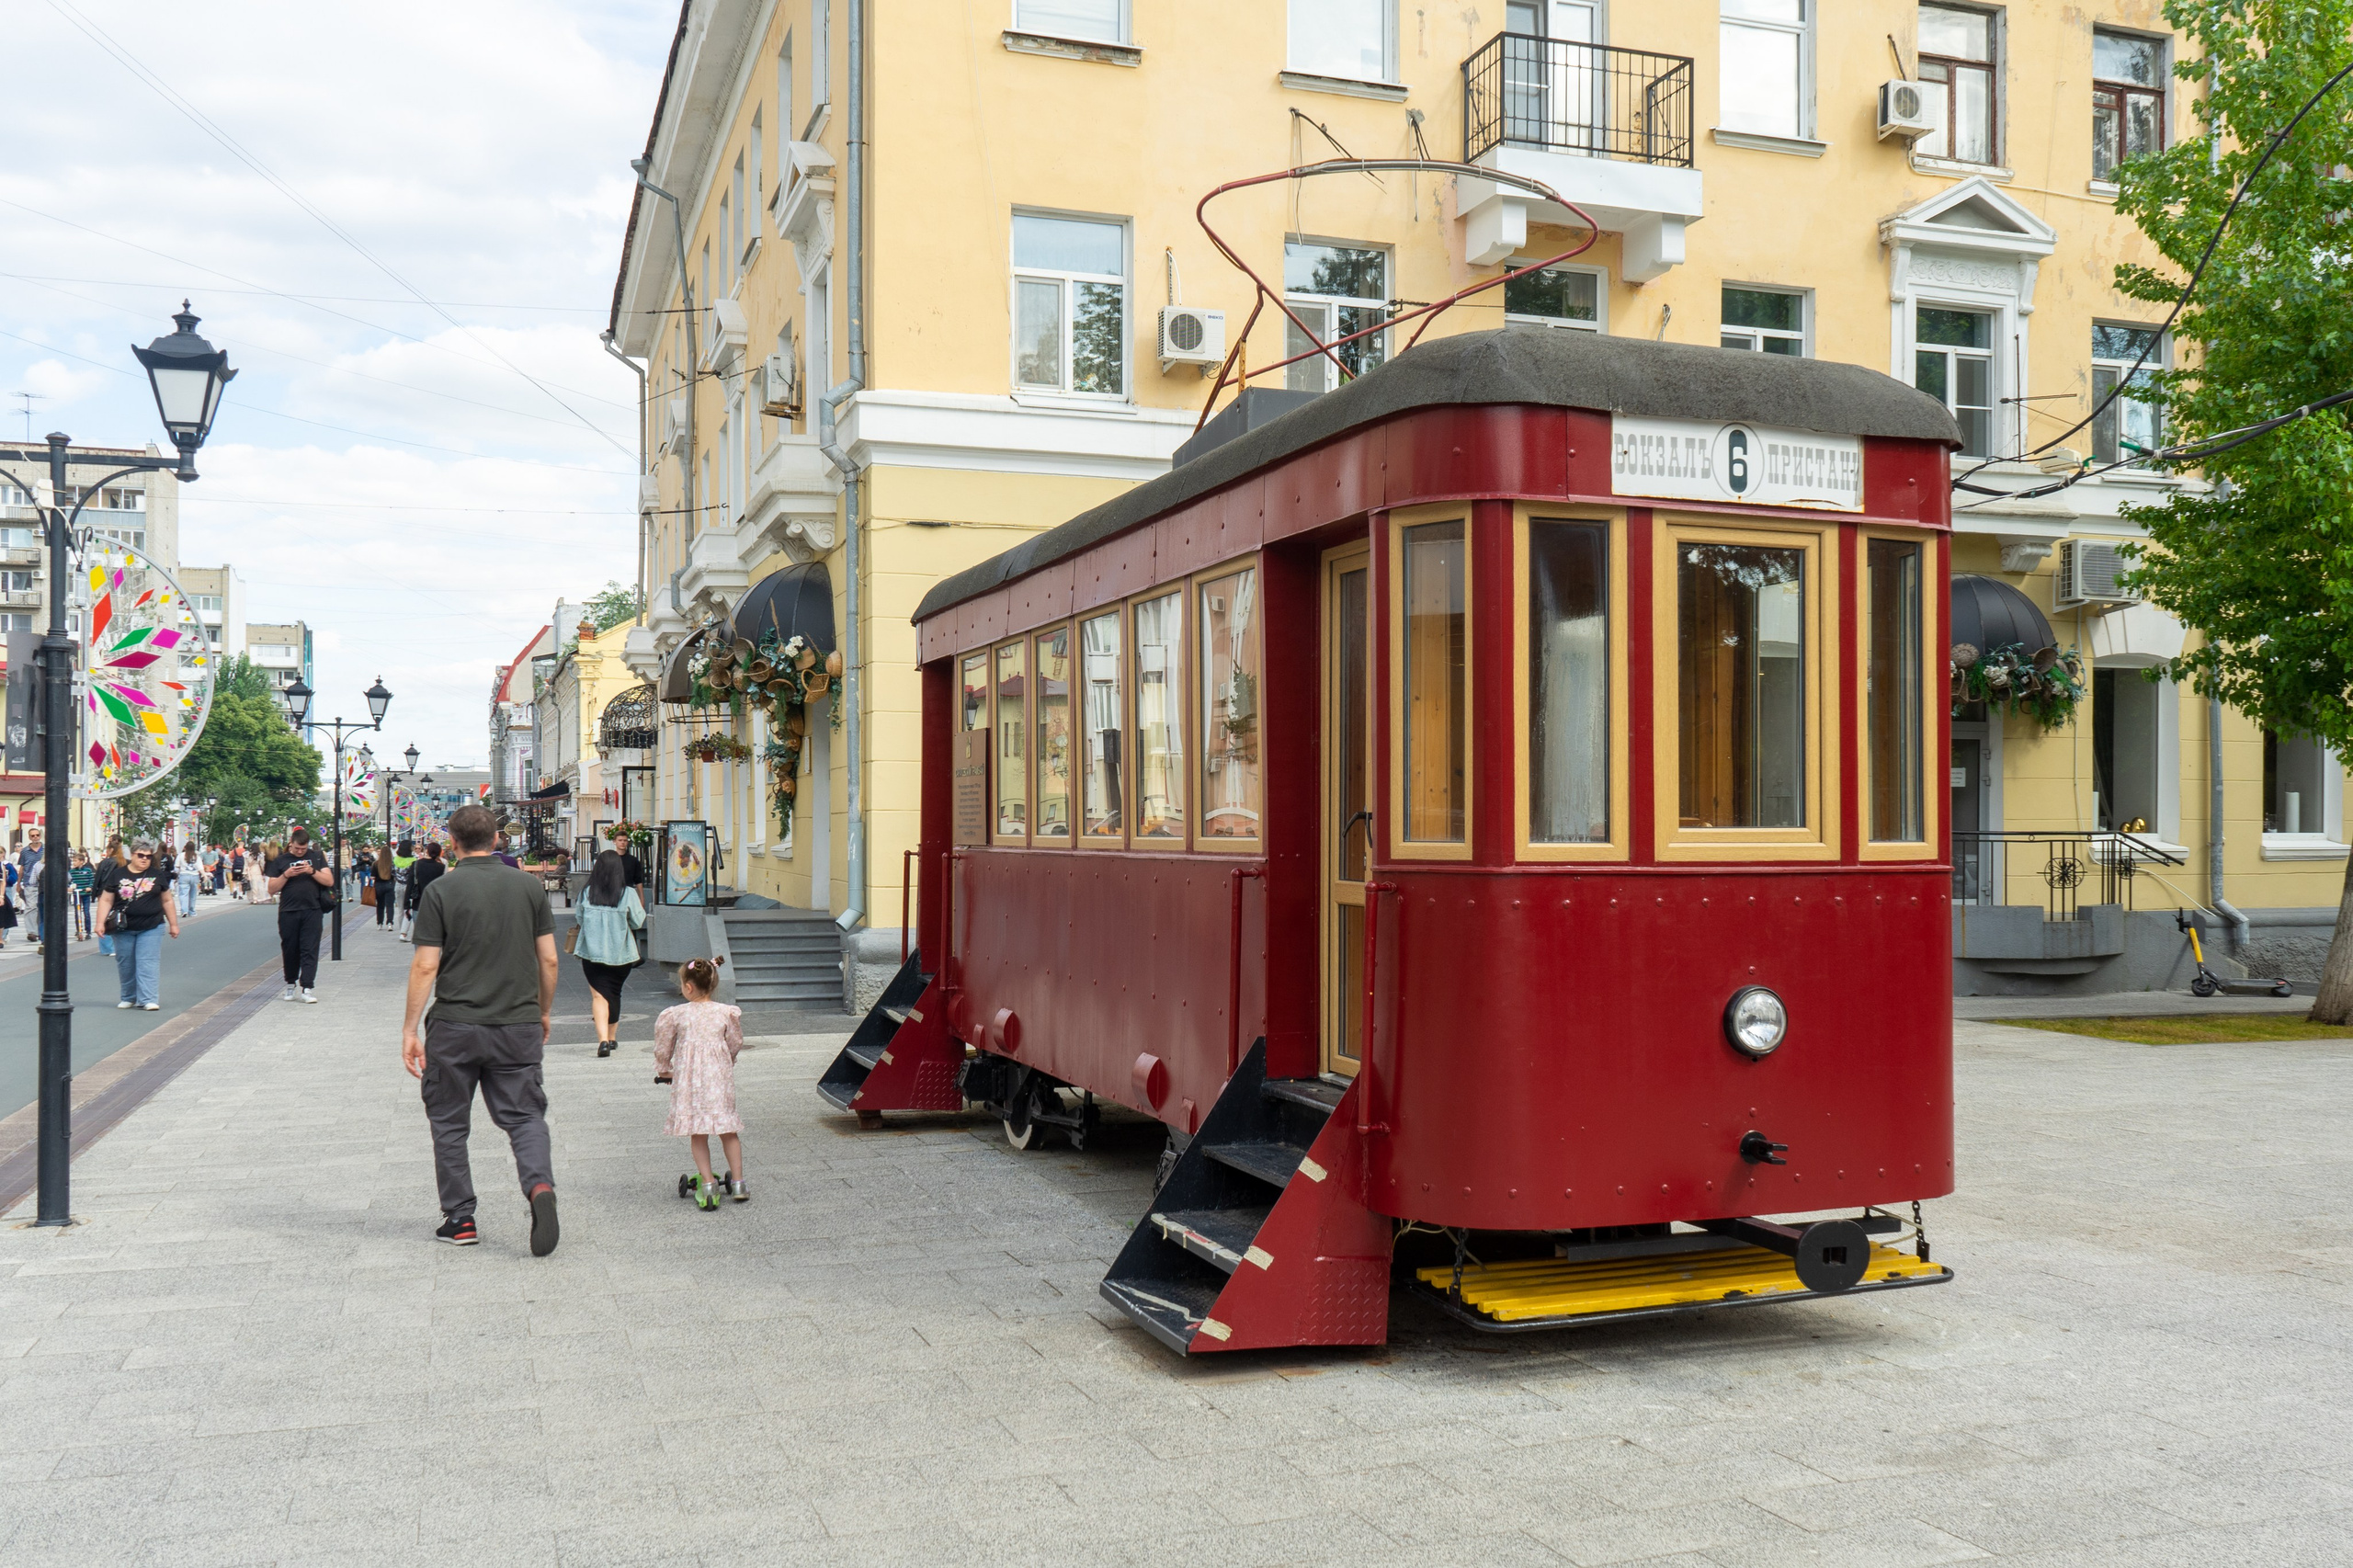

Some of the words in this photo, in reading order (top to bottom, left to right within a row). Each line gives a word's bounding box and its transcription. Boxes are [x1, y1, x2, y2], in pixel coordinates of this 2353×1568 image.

[1614, 433, 1711, 479] ВОКЗАЛЪ
[1728, 429, 1748, 493] 6
[671, 824, 701, 832] ЗАВТРАКИ
